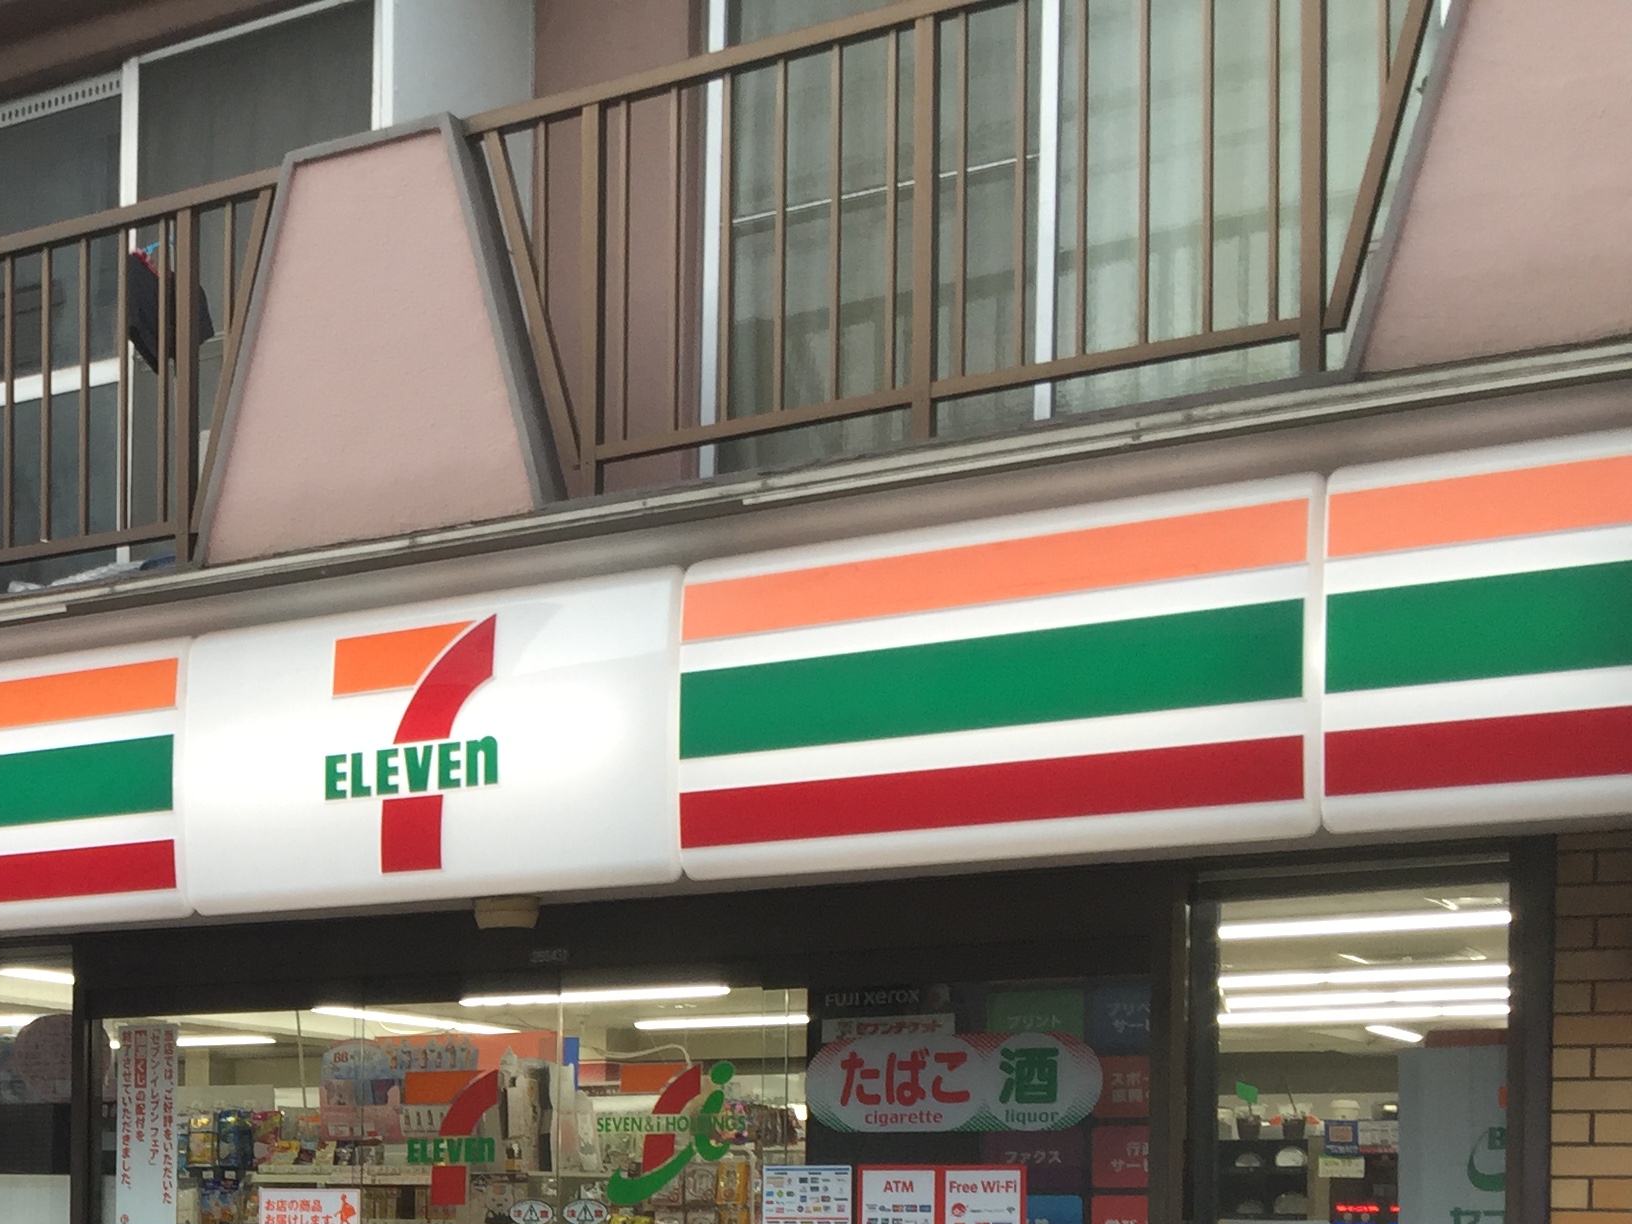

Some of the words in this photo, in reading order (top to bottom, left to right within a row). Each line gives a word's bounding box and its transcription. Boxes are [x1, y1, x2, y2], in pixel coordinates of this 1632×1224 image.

[332, 613, 497, 874] 7
[1007, 1014, 1063, 1030] プリント
[839, 1047, 970, 1107] たばこ
[999, 1047, 1059, 1104] 酒
[865, 1109, 944, 1127] cigarette
[1005, 1109, 1059, 1127] liquor
[1005, 1150, 1062, 1165] ファクス
[883, 1180, 915, 1193] ATM
[949, 1179, 978, 1194] Free
[981, 1179, 1017, 1194] Wi-Fi
[264, 1199, 323, 1212] お店の商品
